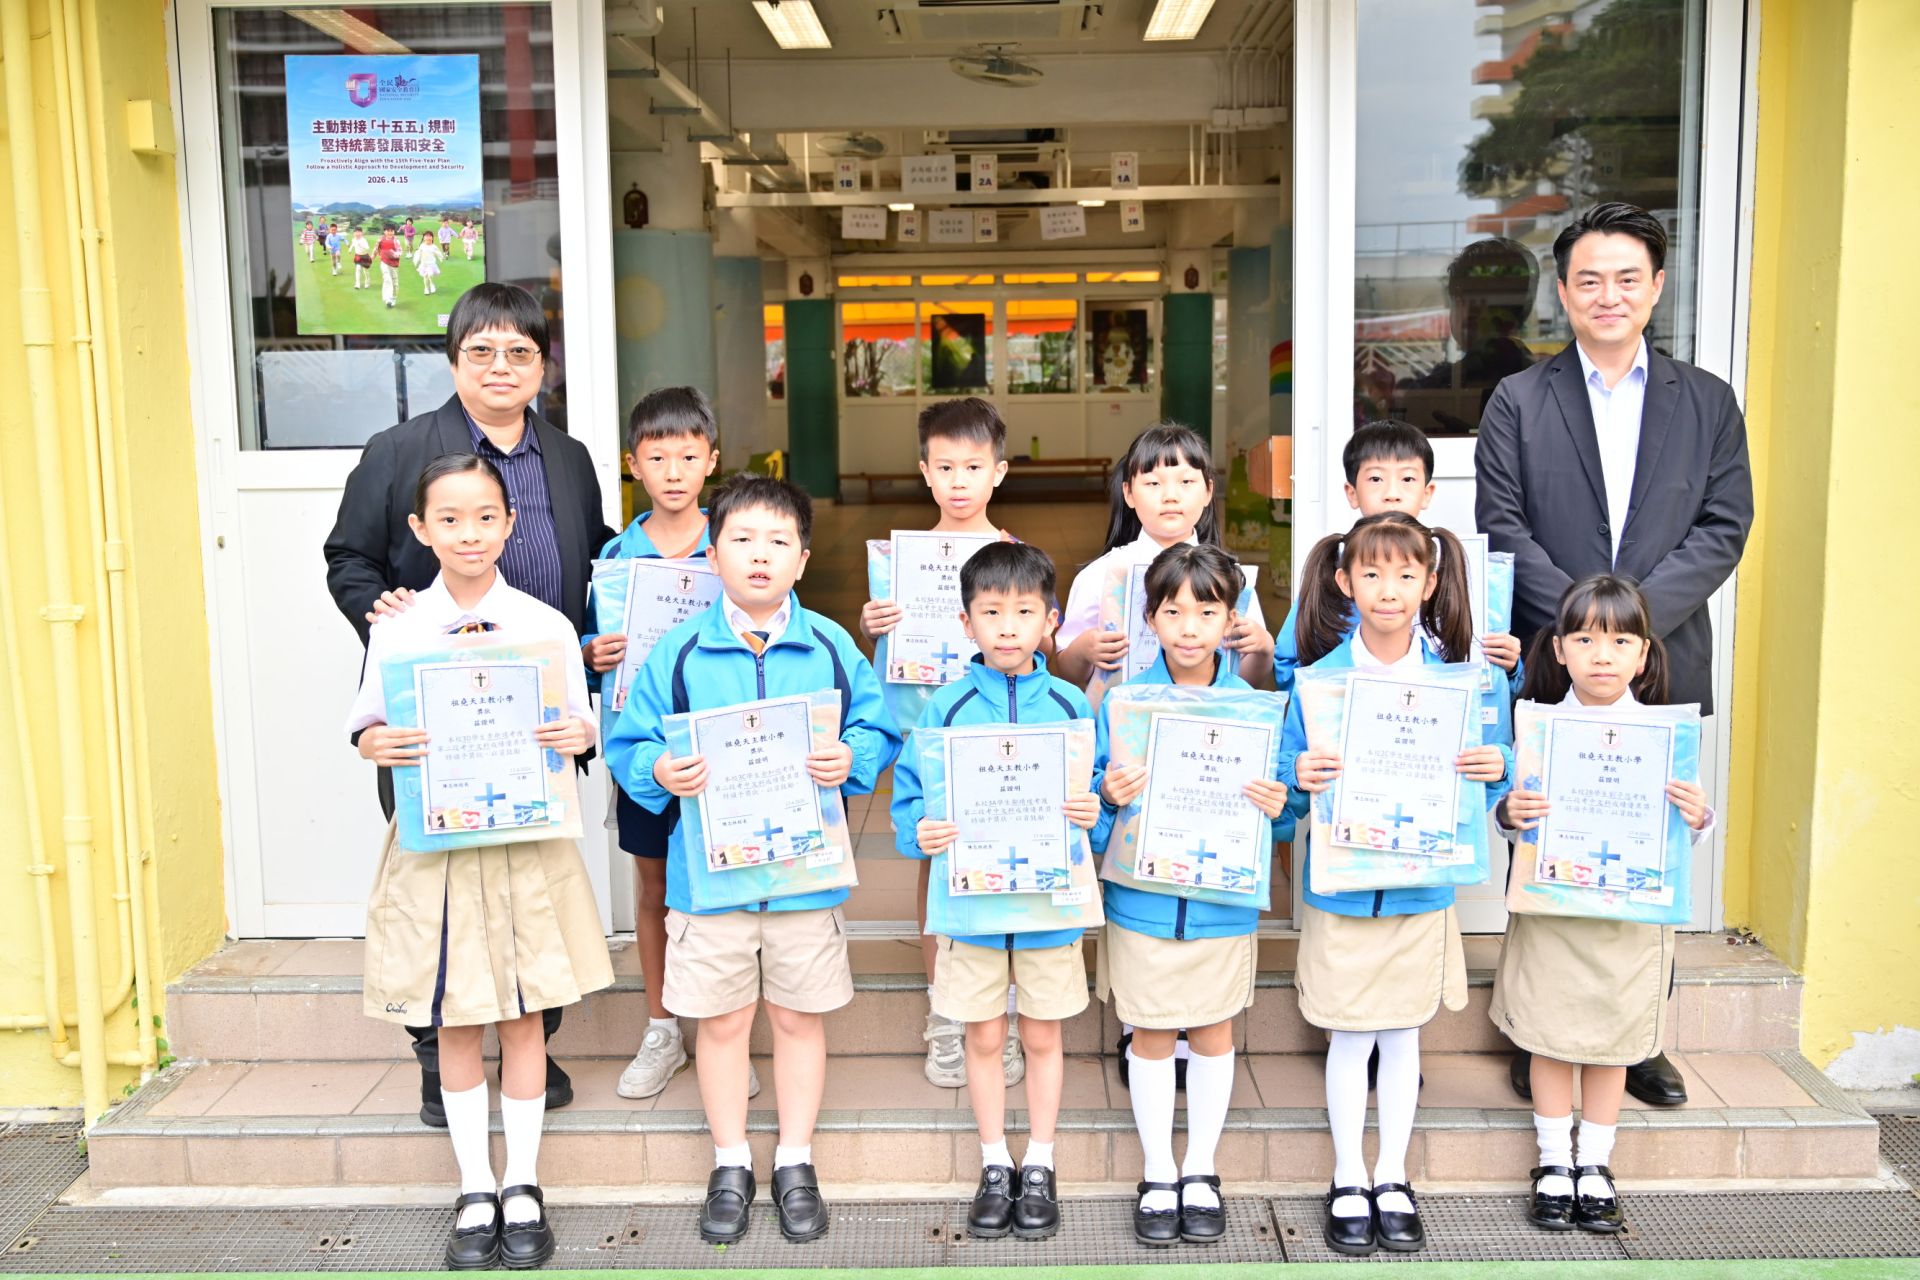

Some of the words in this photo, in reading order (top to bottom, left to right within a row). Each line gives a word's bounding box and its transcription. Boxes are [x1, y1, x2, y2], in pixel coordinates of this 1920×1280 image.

[312, 119, 455, 134] 主動對接「十五五」規劃
[321, 138, 445, 152] 堅持統籌發展和安全
[978, 178, 993, 186] 2A
[1117, 175, 1130, 183] 1A
[920, 564, 963, 572] 祖堯天主教
[656, 594, 712, 608] 祖堯天主教小學
[451, 695, 514, 707] 祖堯天主教小學
[1376, 712, 1439, 727] 祖堯天主教小學
[725, 732, 785, 748] 祖堯天主教小學
[1181, 750, 1242, 765] 祖堯天主教小學
[1578, 752, 1642, 764] 祖堯天主教小學
[979, 763, 1040, 773] 祖堯天主教小學
